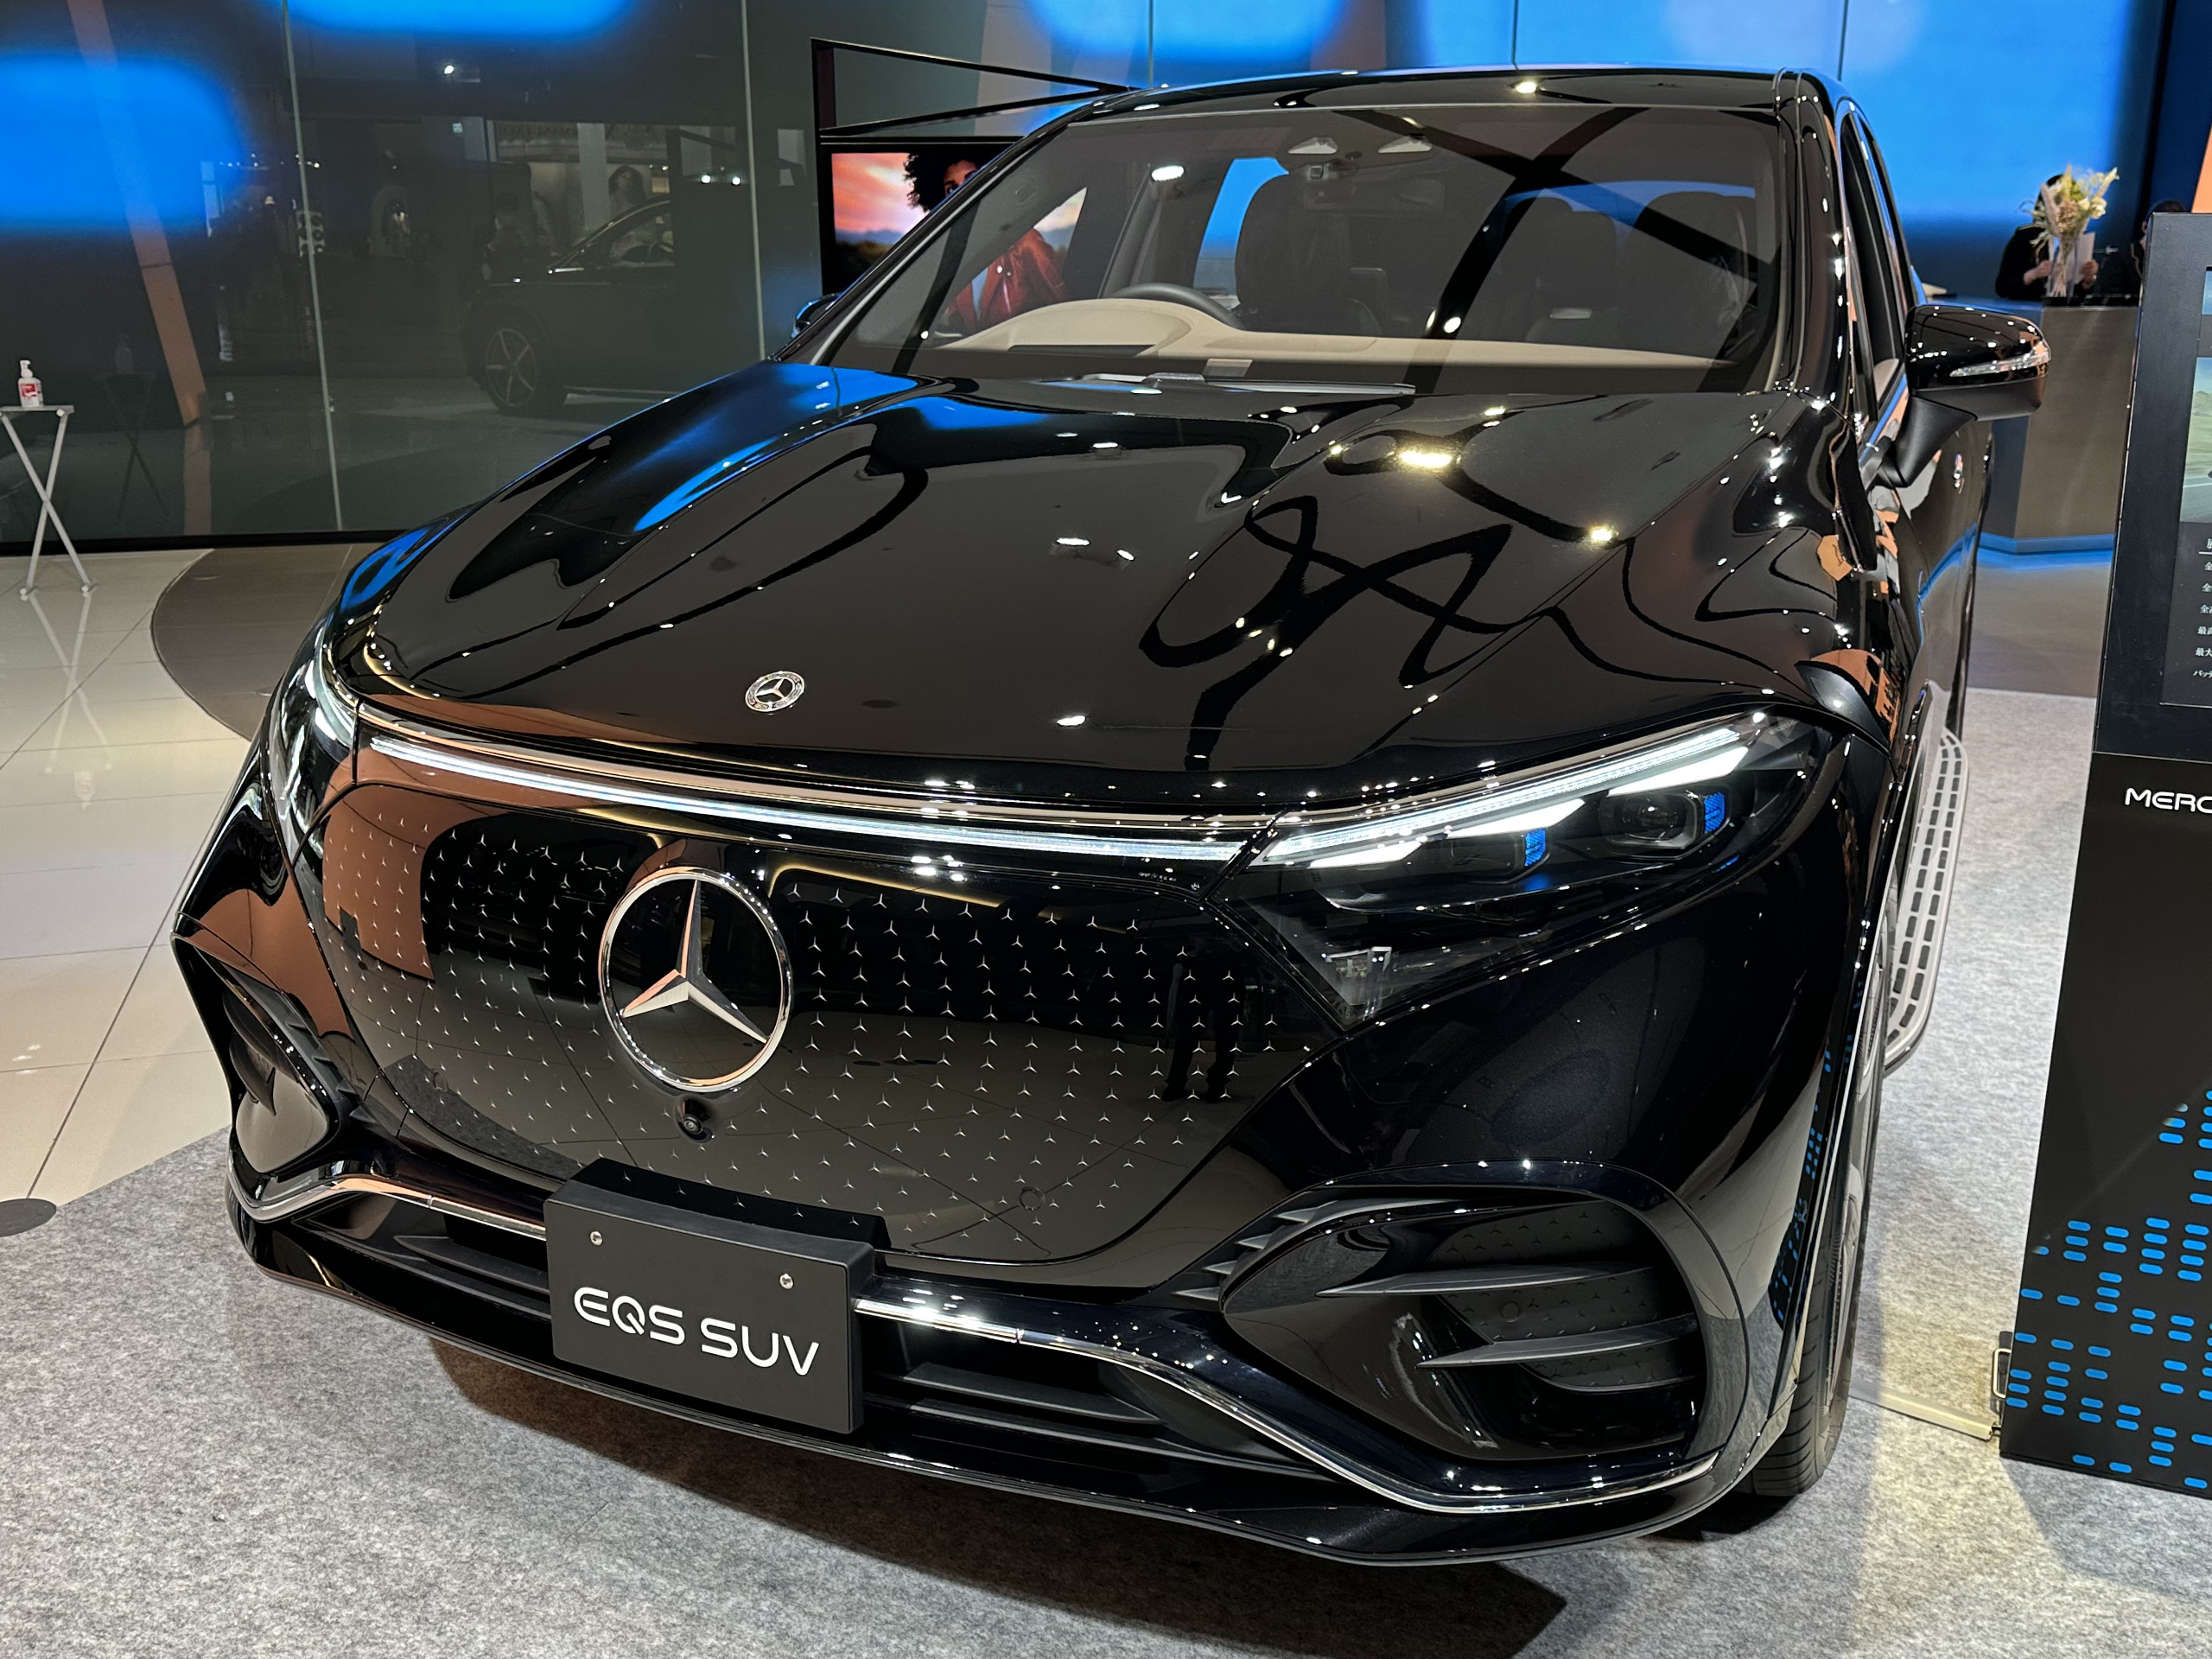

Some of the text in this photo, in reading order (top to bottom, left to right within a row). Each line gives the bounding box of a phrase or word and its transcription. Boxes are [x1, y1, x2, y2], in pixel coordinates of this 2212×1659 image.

[2125, 787, 2212, 814] MERC
[574, 1287, 820, 1376] EQS SUV
